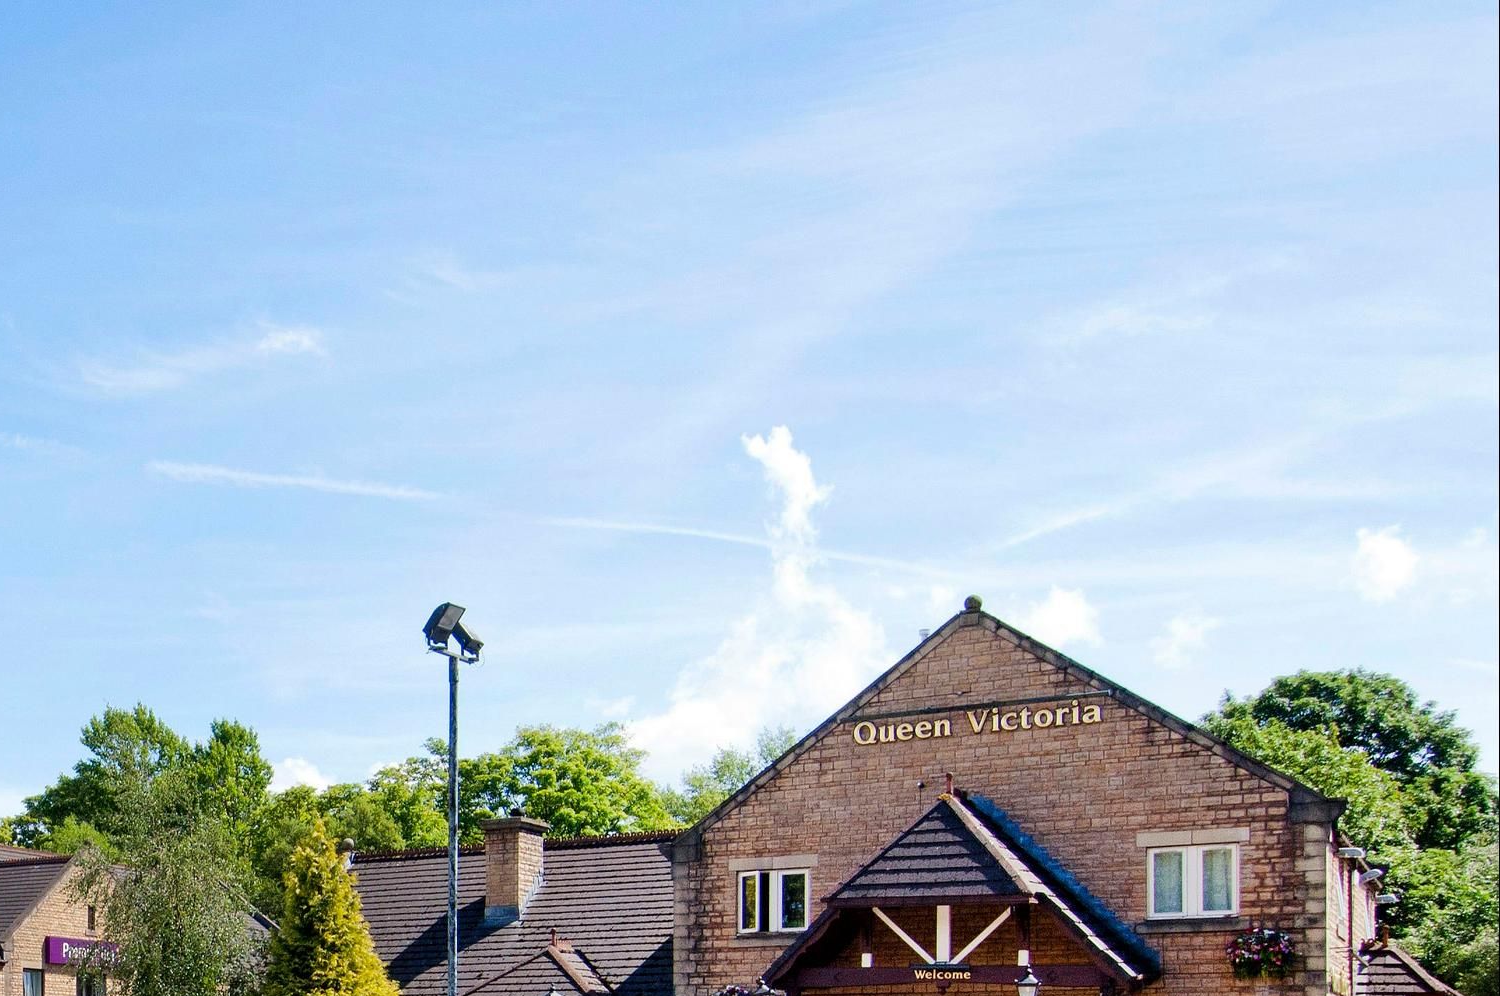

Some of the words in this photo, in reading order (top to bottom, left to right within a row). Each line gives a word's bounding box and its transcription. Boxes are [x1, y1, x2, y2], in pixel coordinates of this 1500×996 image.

[853, 719, 952, 745] Queen
[967, 700, 1102, 734] Victoria
[914, 969, 971, 980] Welcome
